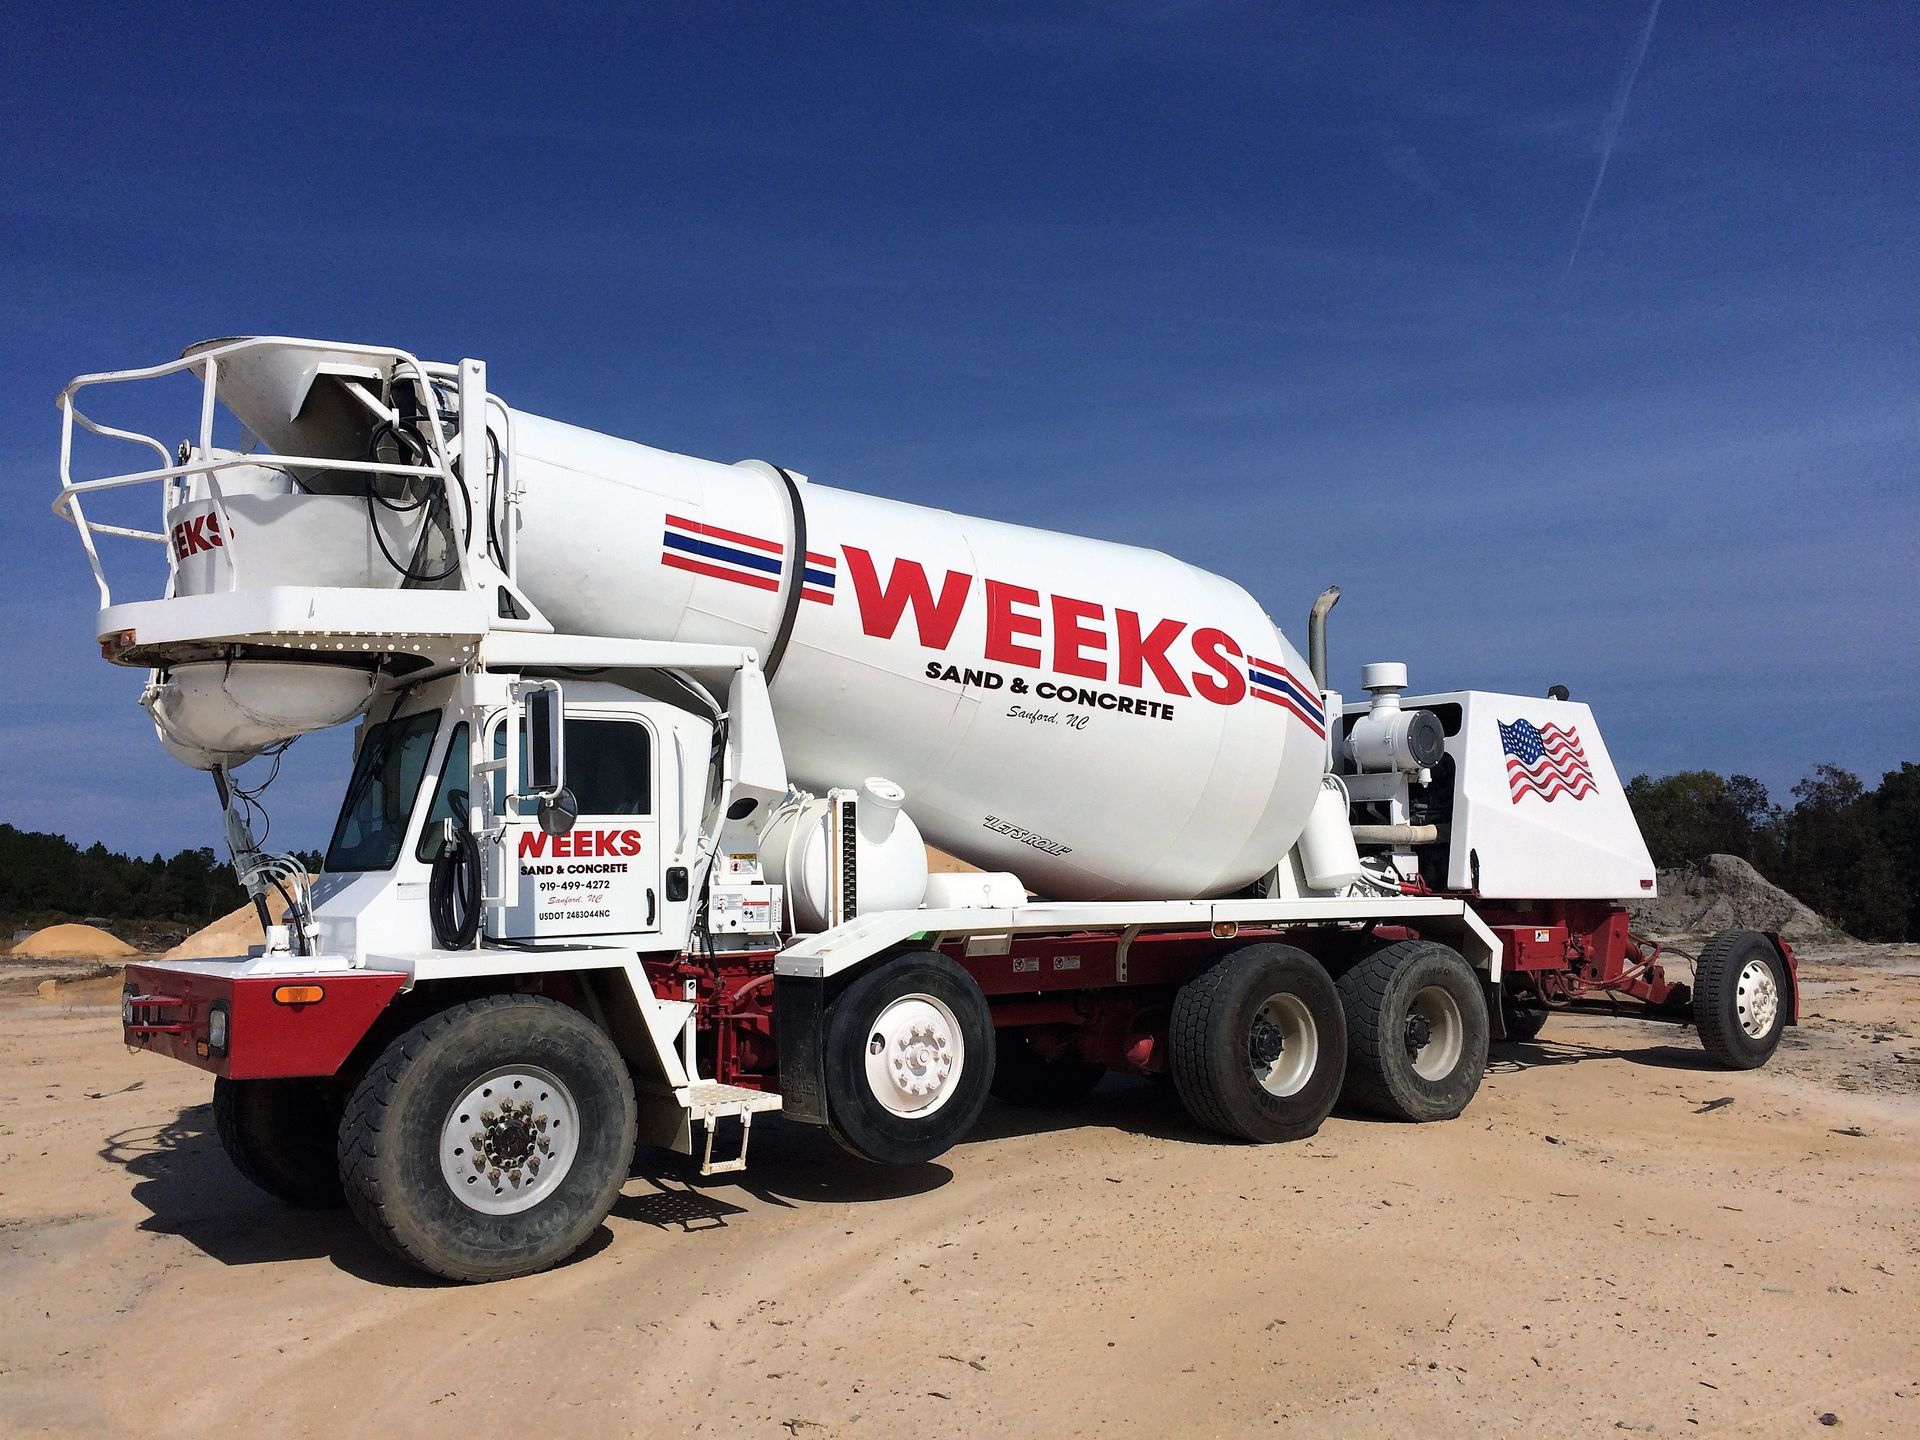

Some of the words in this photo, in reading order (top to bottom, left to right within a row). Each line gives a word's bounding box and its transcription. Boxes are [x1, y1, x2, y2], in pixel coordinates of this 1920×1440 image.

[171, 512, 235, 560] EKS
[840, 544, 1247, 706] WEEKS
[925, 661, 1004, 690] SAND
[1010, 677, 1028, 695] &
[1035, 682, 1175, 721] CONCRETE
[1066, 713, 1090, 731] NC
[518, 829, 642, 859] WEEKS
[520, 865, 554, 876] SAND
[556, 864, 565, 875] &
[567, 863, 628, 874] CONCRETE
[539, 880, 611, 892] 919-499-4272
[587, 894, 604, 904] NC
[538, 911, 565, 921] USDOT
